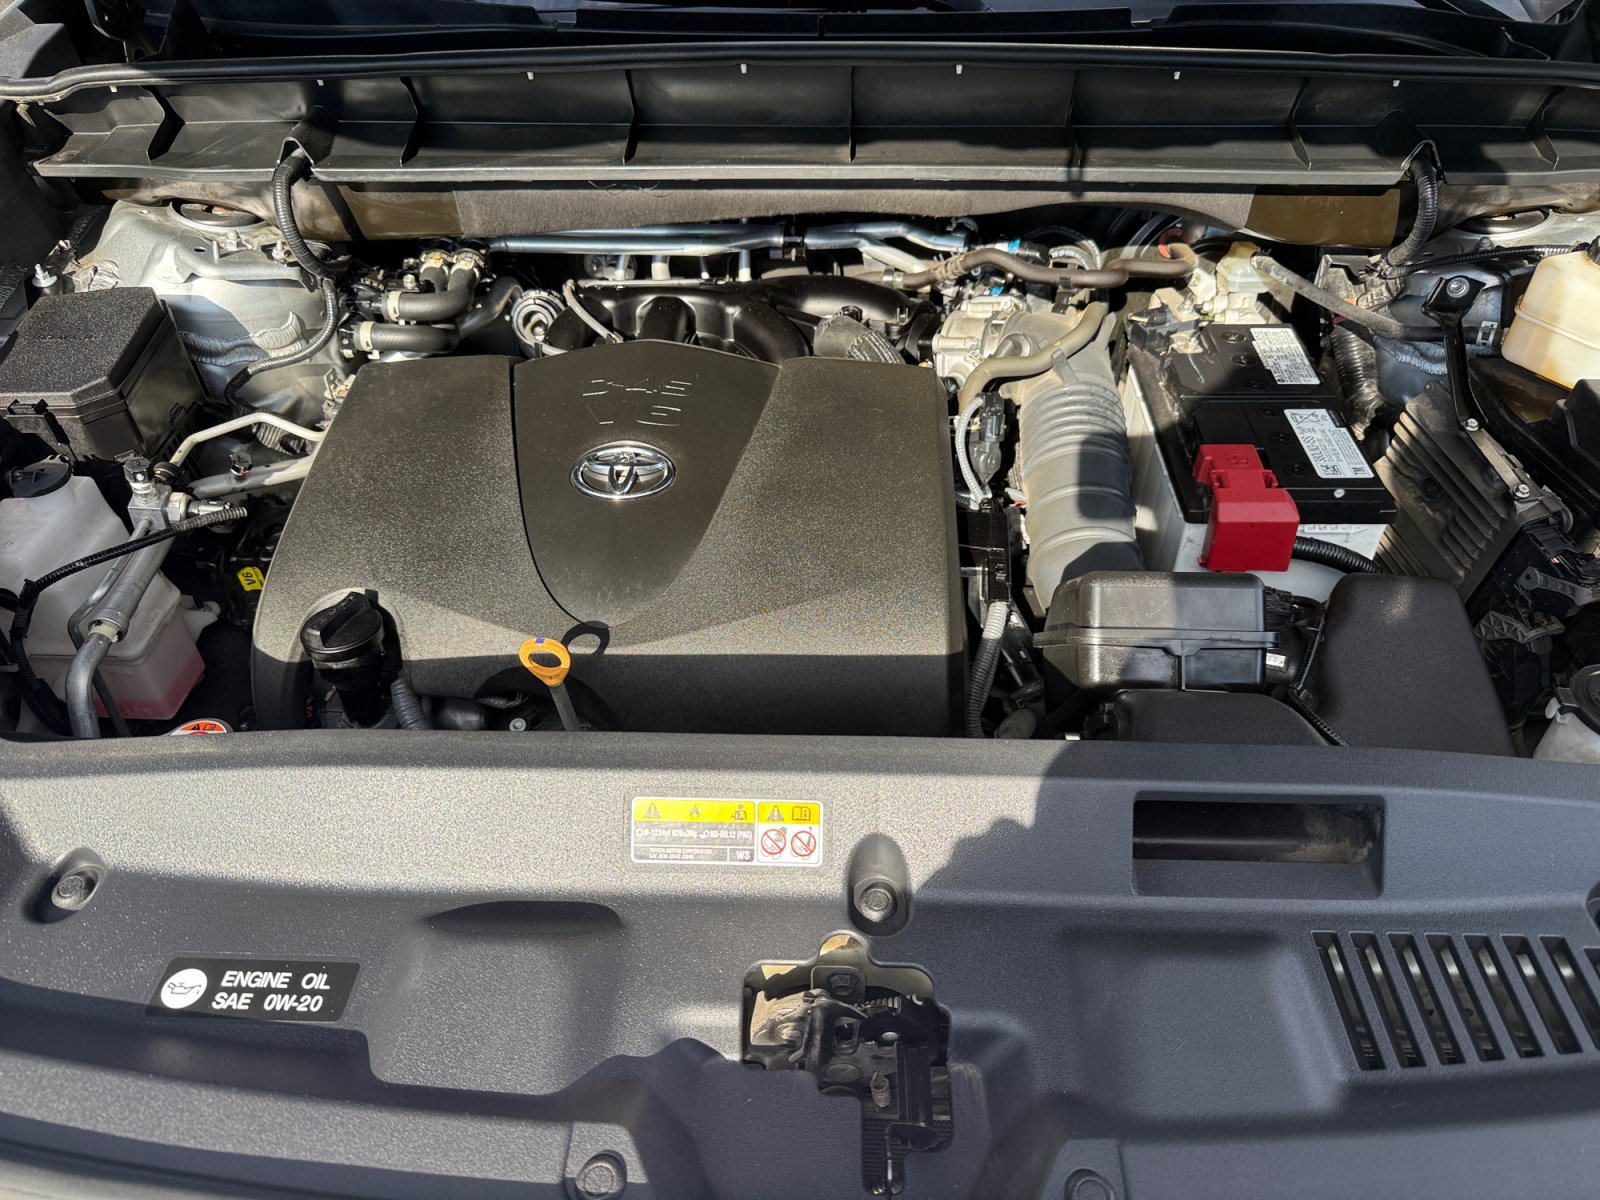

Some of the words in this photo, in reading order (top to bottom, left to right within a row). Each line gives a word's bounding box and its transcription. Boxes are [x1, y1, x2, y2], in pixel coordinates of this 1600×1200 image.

[1352, 467, 1367, 475] TM
[242, 571, 257, 586] V6
[736, 850, 751, 860] WS
[221, 970, 293, 989] ENGINE
[301, 972, 331, 990] OIL
[211, 991, 254, 1010] SAE
[263, 993, 324, 1012] 0W-20
